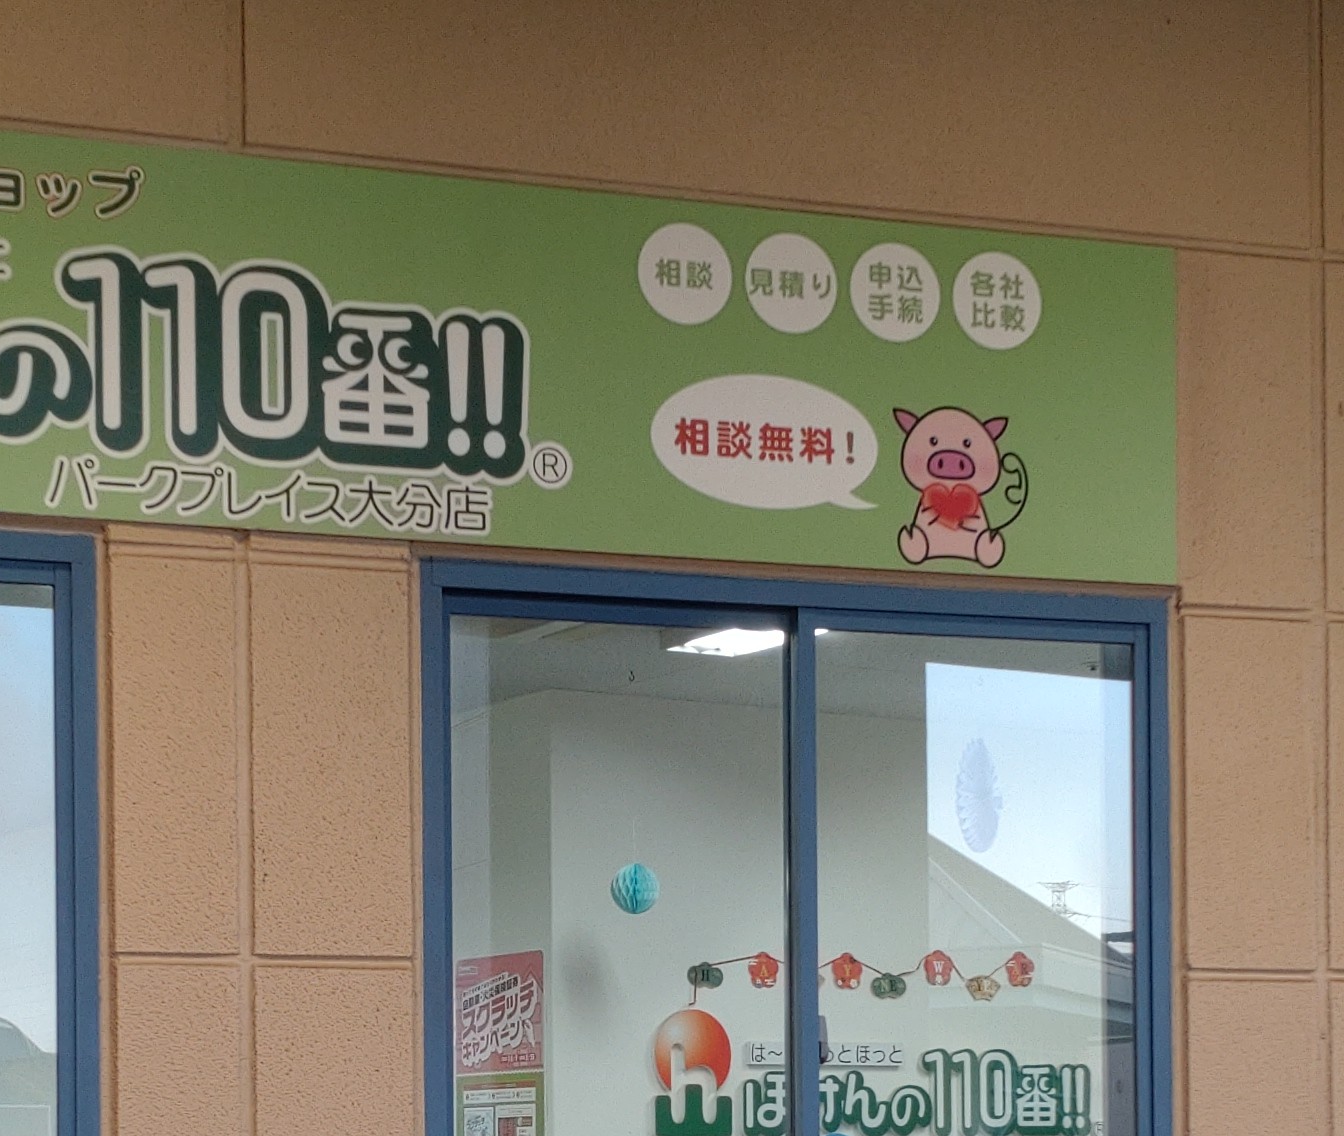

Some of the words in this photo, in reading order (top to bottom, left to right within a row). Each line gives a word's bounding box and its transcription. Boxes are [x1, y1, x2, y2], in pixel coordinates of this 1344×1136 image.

[655, 257, 715, 292] 相談
[749, 267, 833, 300] 見積り
[867, 261, 924, 293] 申込
[969, 269, 1026, 301] 各社
[867, 293, 924, 325] 手続
[970, 301, 1027, 333] 比較
[49, 459, 490, 533] パークプレイス大分店
[462, 980, 535, 1040] スクラッチ
[461, 1018, 524, 1066] キャンペーン
